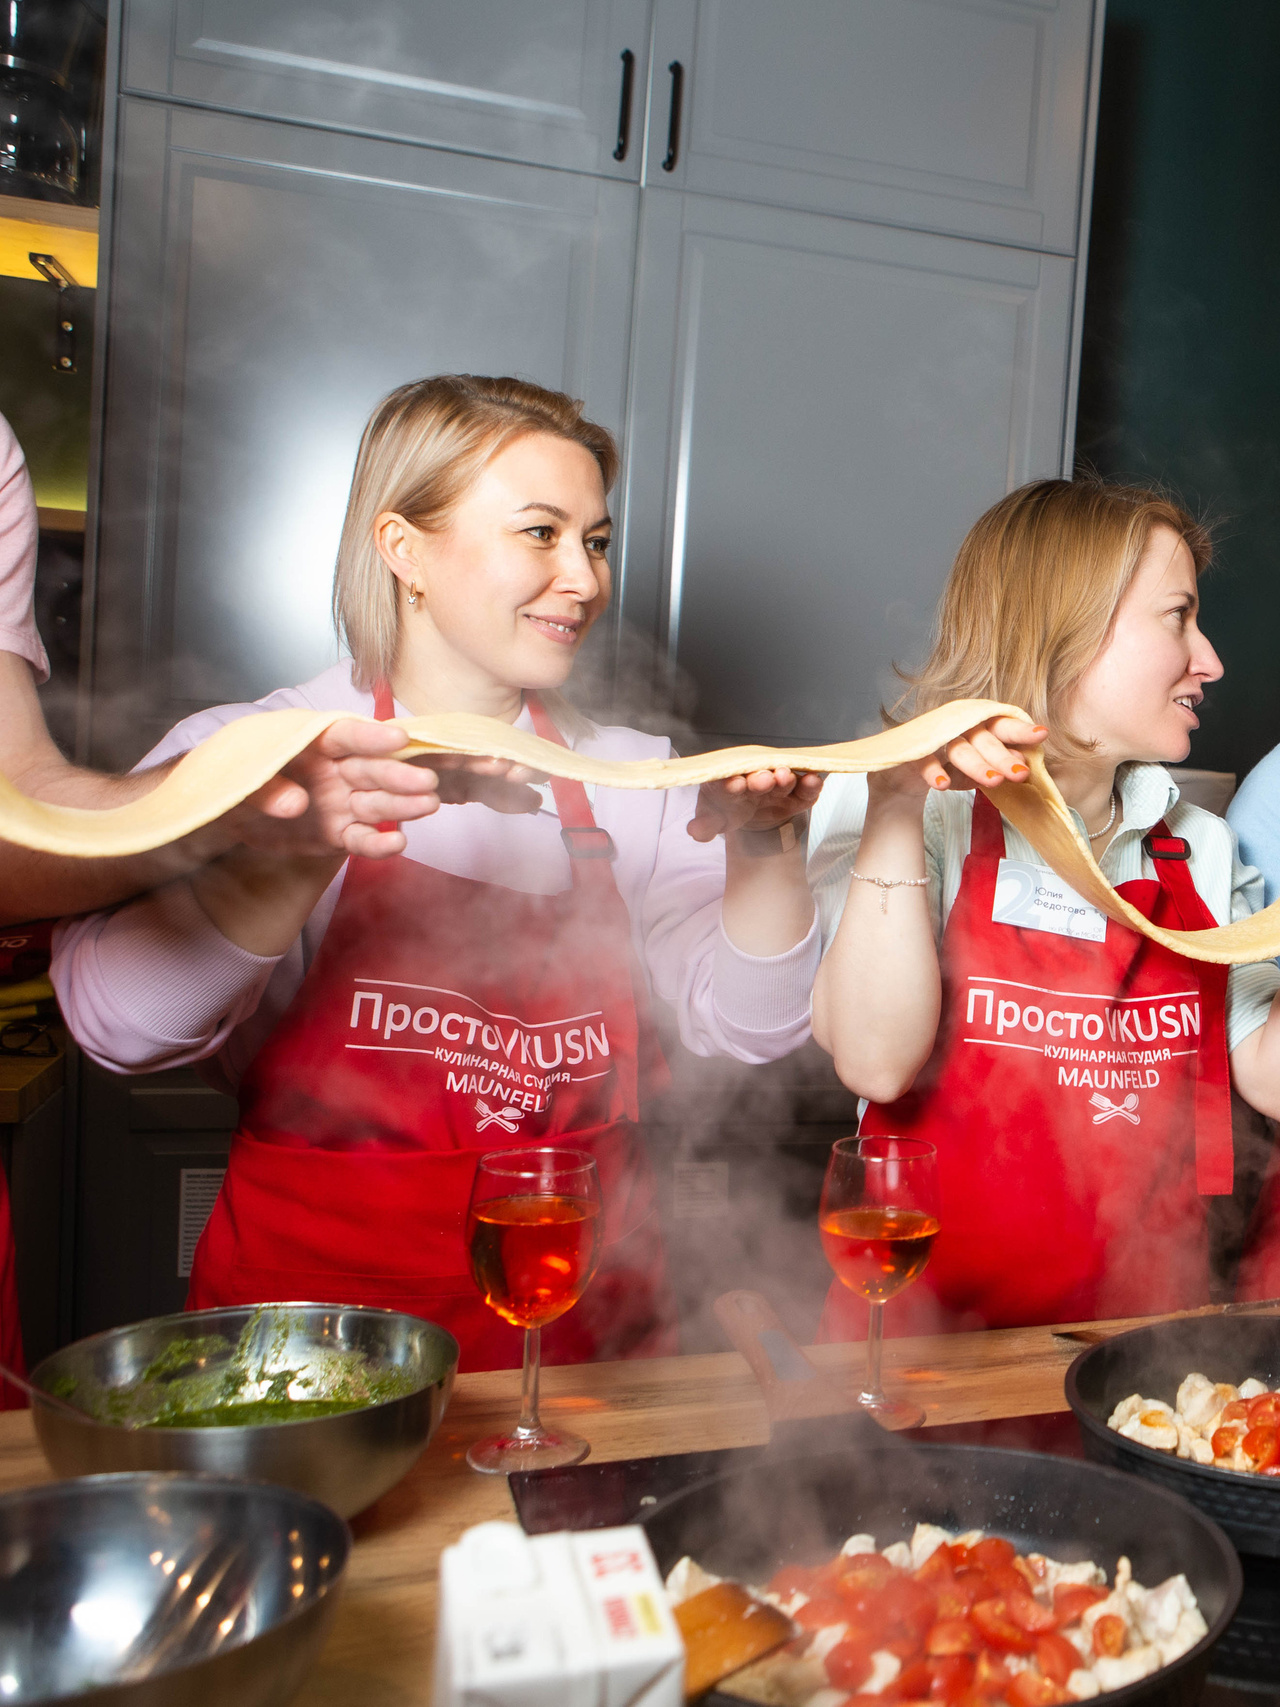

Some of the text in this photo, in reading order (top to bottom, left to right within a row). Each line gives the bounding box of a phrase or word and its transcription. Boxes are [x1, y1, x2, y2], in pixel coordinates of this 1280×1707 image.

[1034, 898, 1086, 916] Федотова
[1044, 1044, 1171, 1065] КУЛИНАРНАЯ СТУДИЯ
[434, 1046, 571, 1092] КУЛИНАРНАЯ СТУДИЯ
[1058, 1066, 1160, 1089] MAUNFELD
